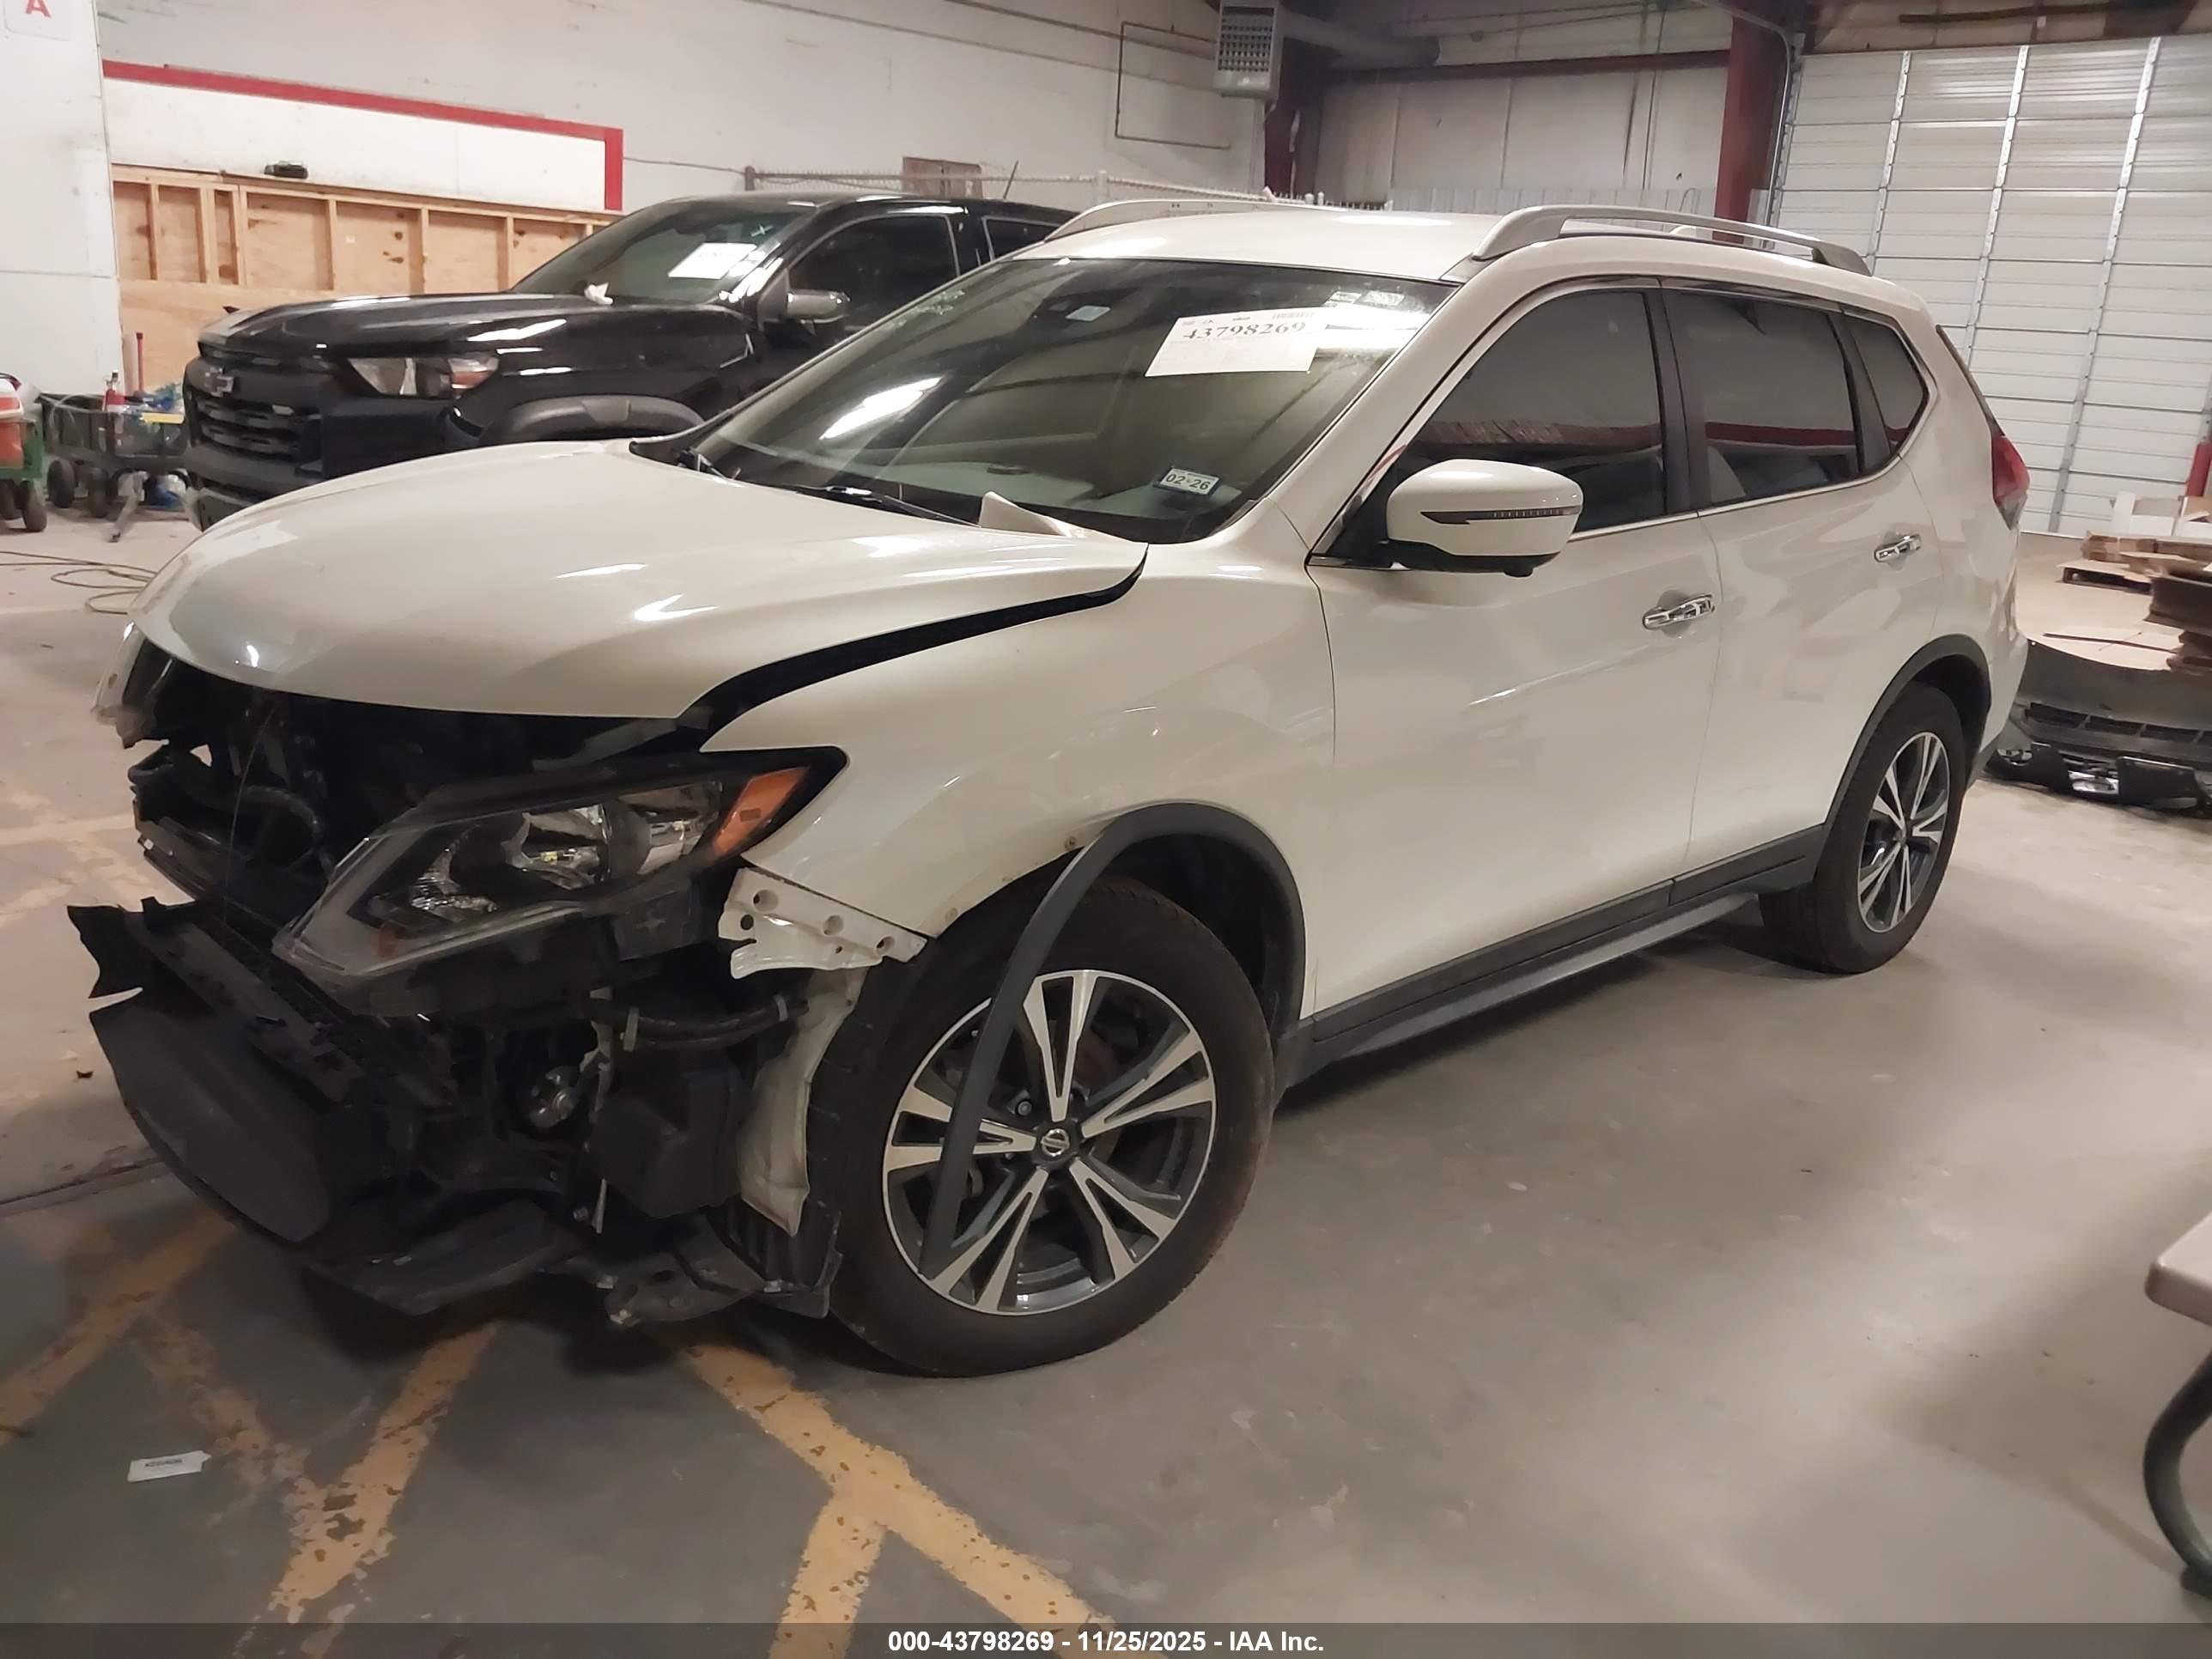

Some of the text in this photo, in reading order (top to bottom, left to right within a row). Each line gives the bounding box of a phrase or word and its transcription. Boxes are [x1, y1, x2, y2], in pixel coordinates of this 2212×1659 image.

[26, 0, 52, 17] A
[1183, 321, 1306, 339] 43798269
[1166, 473, 1186, 485] 02
[1189, 479, 1211, 490] 26
